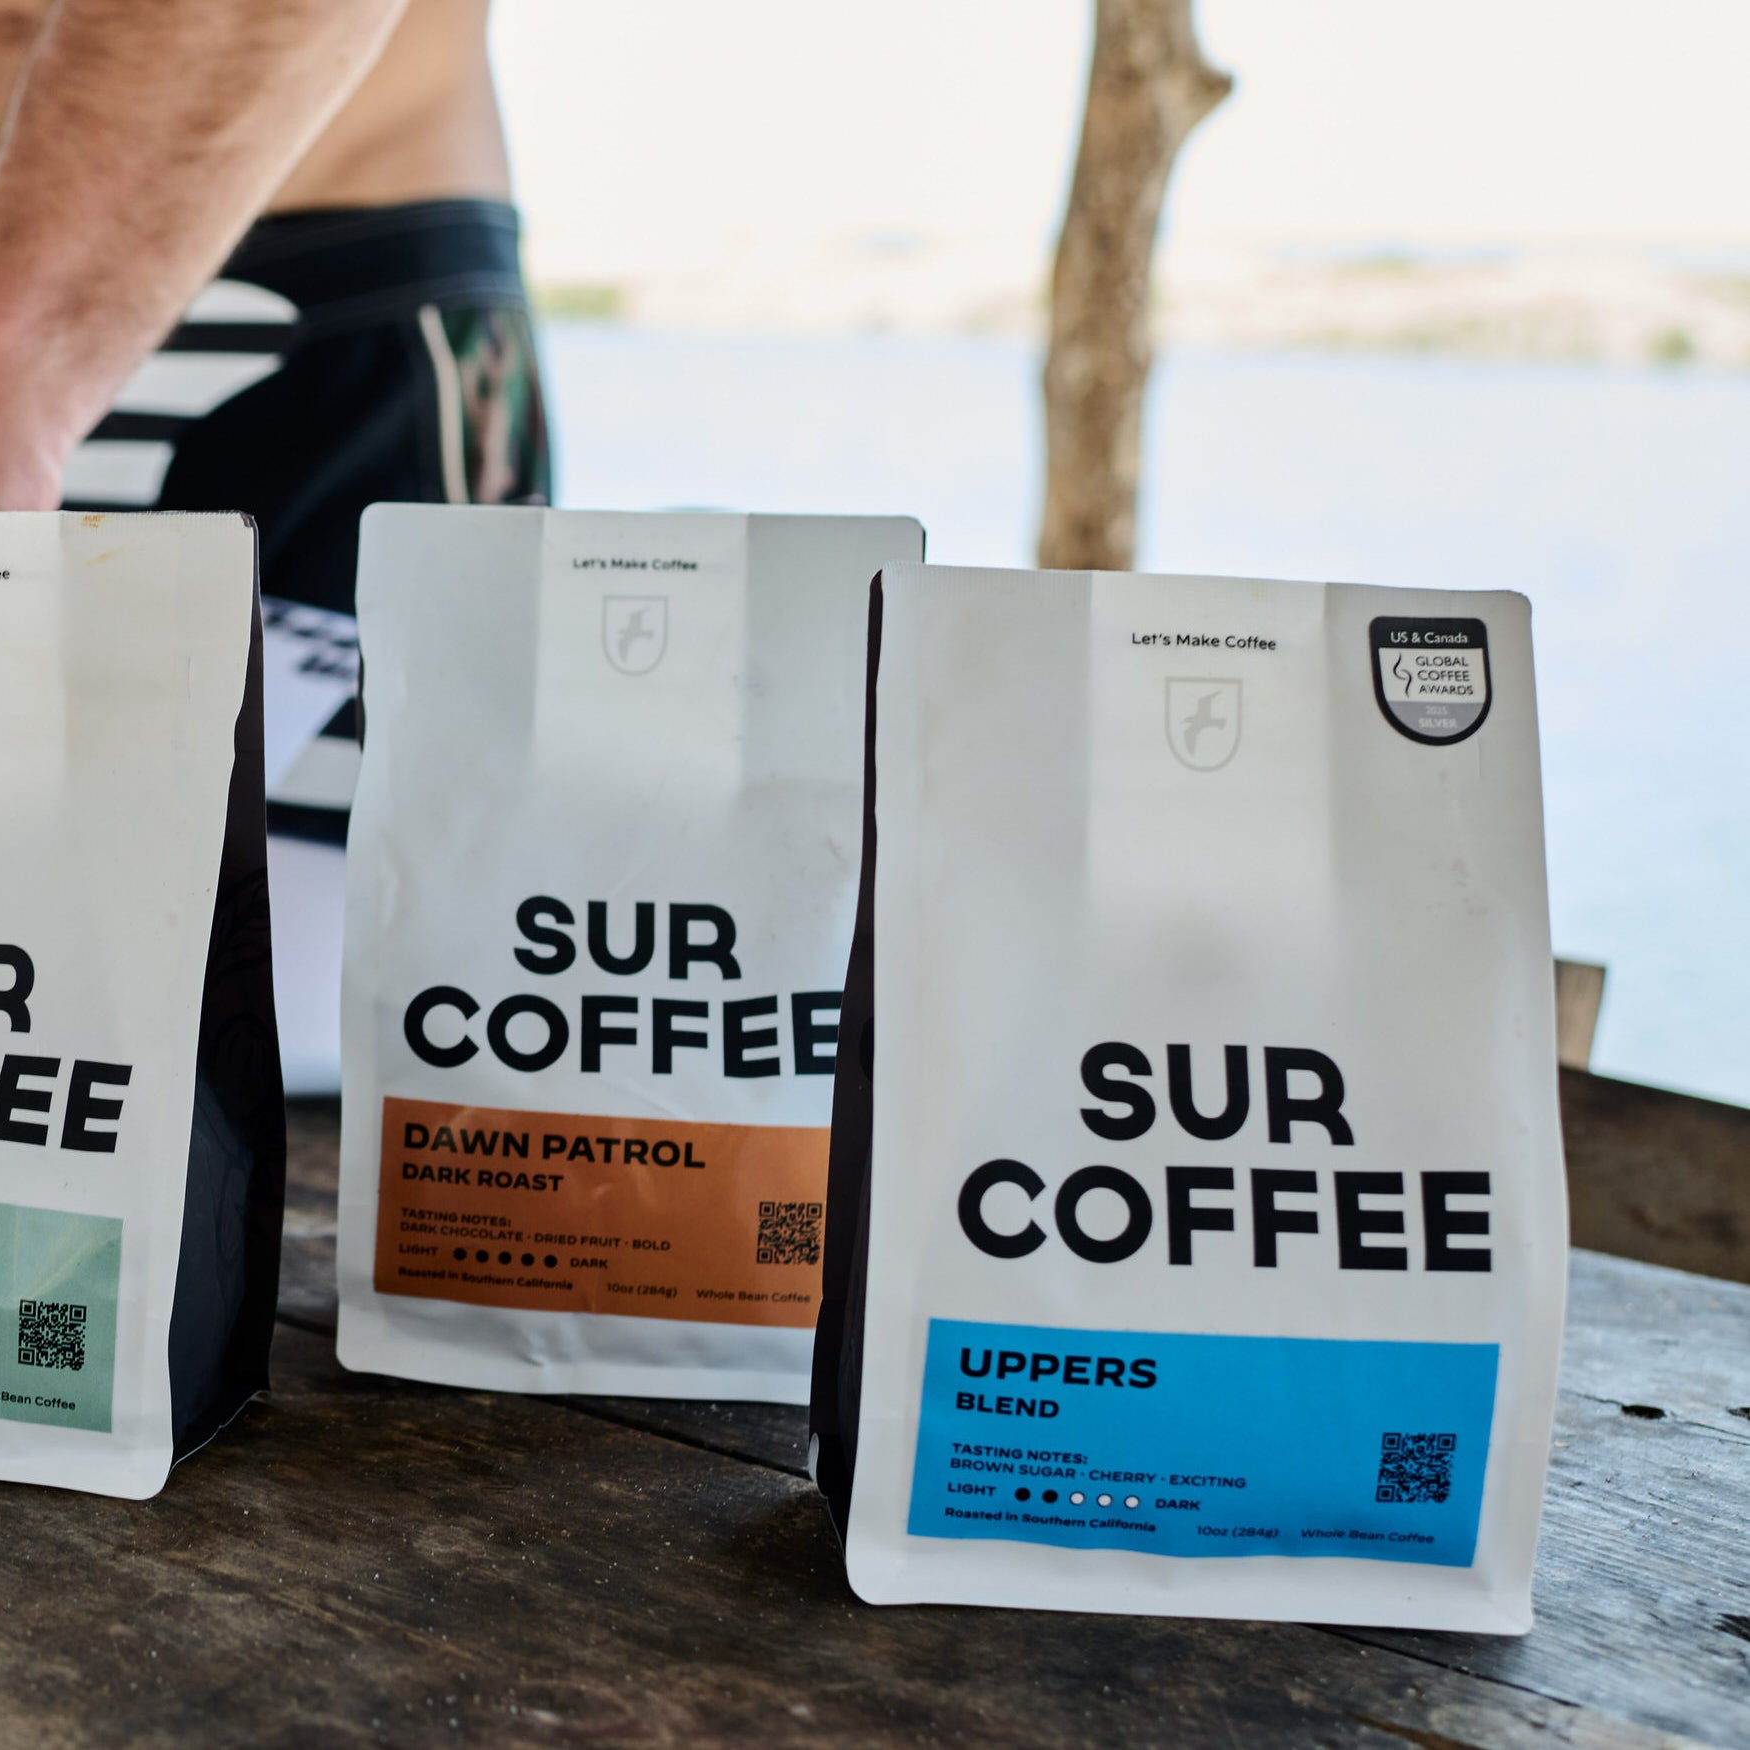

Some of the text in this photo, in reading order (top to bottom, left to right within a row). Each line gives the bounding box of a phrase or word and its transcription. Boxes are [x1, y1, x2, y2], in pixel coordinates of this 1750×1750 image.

[572, 558, 697, 571] Let's Make Coffee
[1132, 633, 1276, 650] Let's Make Coffee
[1391, 631, 1468, 644] US & Canada
[1415, 656, 1469, 667] GLOBAL
[1417, 670, 1471, 681] COFFEE
[1419, 685, 1474, 696] AWARDS
[1418, 718, 1458, 729] SILVER
[514, 895, 742, 980] SUR
[403, 985, 844, 1078] COFFEE
[1079, 1041, 1355, 1146] SUR
[403, 1122, 706, 1169] DAWN PATROL
[401, 1163, 564, 1192] DARK ROAST
[401, 1207, 511, 1227] TASTING NOTES:
[957, 1158, 1492, 1272] COFFEE
[400, 1221, 671, 1251] DARK CHOCOLATE DRIED FRUIT BOLD
[399, 1243, 608, 1269] LIGHT DARK
[398, 1266, 573, 1291] Roasted in Southern California
[607, 1282, 678, 1298] 10oz (284g)
[697, 1289, 811, 1303] Whole Bean Coffee
[960, 1347, 1157, 1389] UPPERS
[1, 1391, 31, 1405] Bean
[35, 1396, 76, 1410] Coffee
[955, 1392, 1059, 1419] BLEND
[952, 1442, 1088, 1465] TASTING NOTES:
[950, 1458, 1247, 1489] BROWN SUGAR CHERRY EXCITING
[947, 1482, 1201, 1511] LIGHT DARK
[944, 1507, 1156, 1533] Roasted in Southern California
[1197, 1525, 1279, 1540] 10oz (284g)
[1301, 1528, 1434, 1544] Whole Bean Coffee
